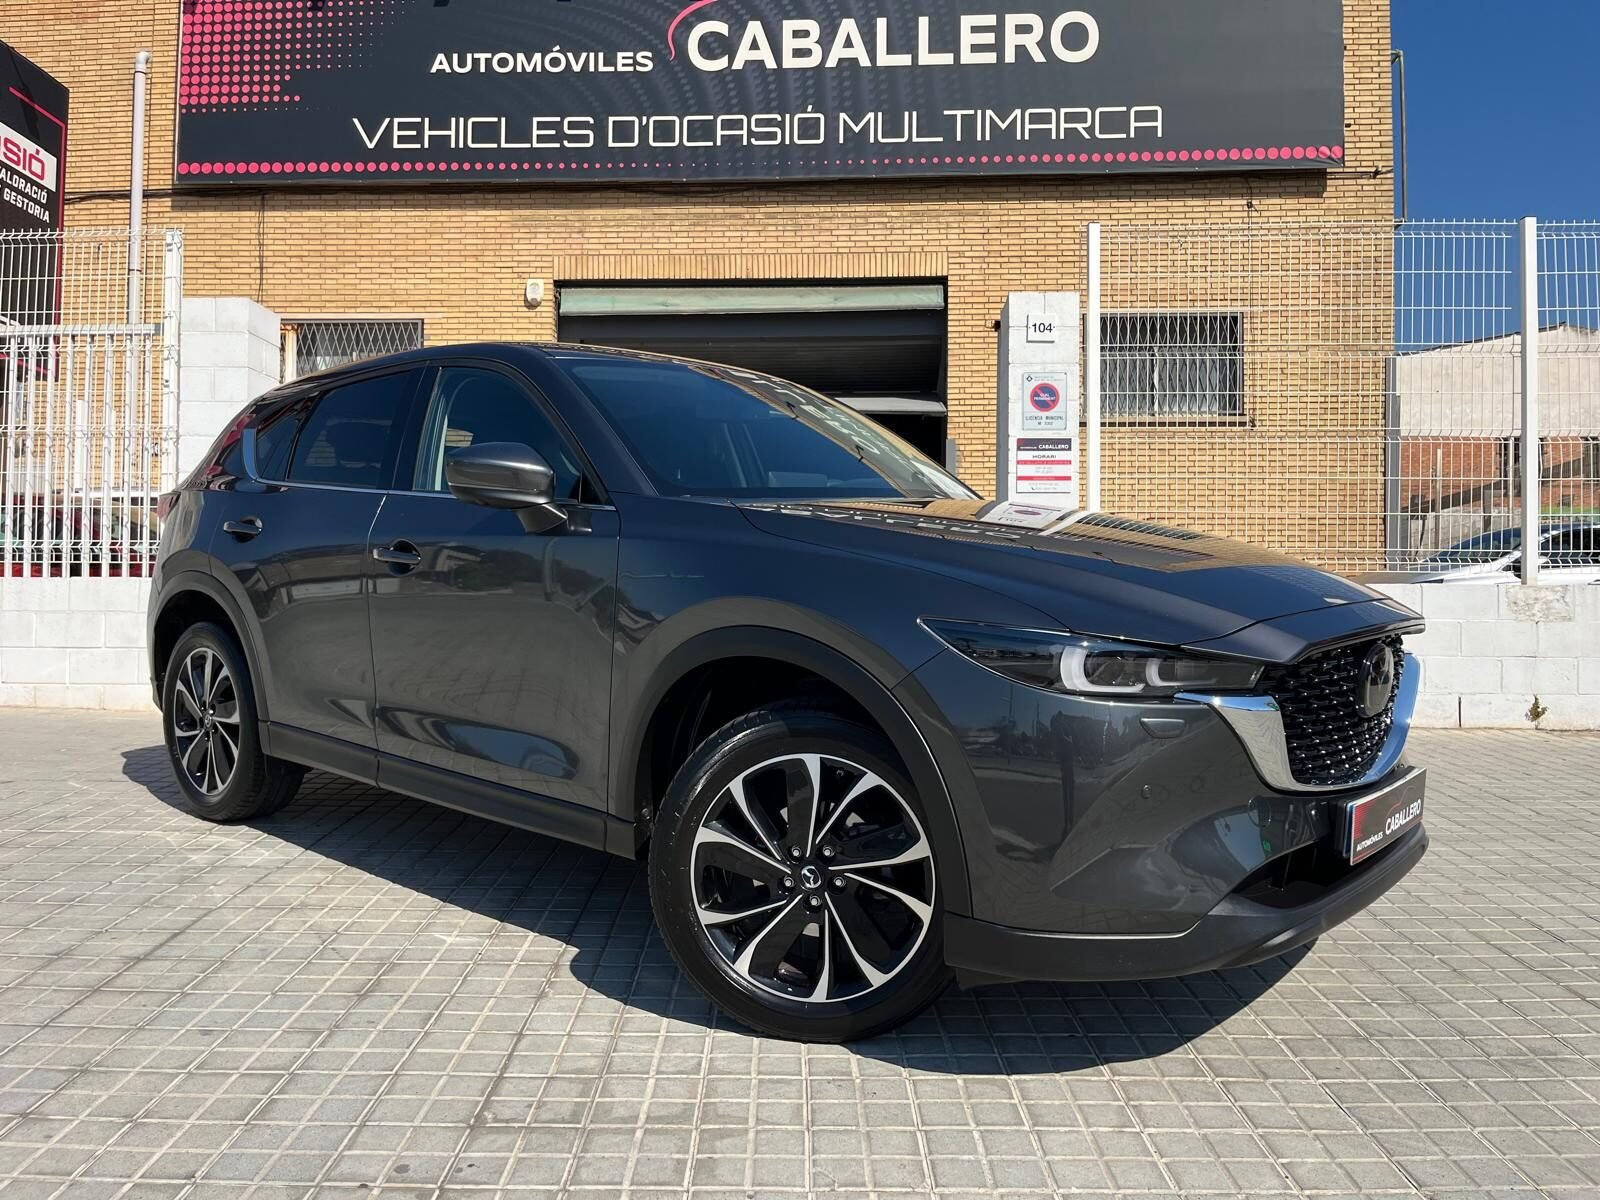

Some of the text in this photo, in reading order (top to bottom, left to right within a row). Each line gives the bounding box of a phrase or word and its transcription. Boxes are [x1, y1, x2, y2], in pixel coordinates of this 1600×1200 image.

[430, 11, 1100, 74] AUTOMÓVILES CABALLERO
[352, 104, 1164, 150] VEHICLES D'OCASIÓ MULTIMARCA
[0, 136, 46, 181] SIÓ
[0, 165, 48, 204] ALORACIÓ
[3, 187, 50, 224] GESTORIA
[1031, 322, 1054, 333] 104
[1385, 799, 1422, 835] CABALLERO
